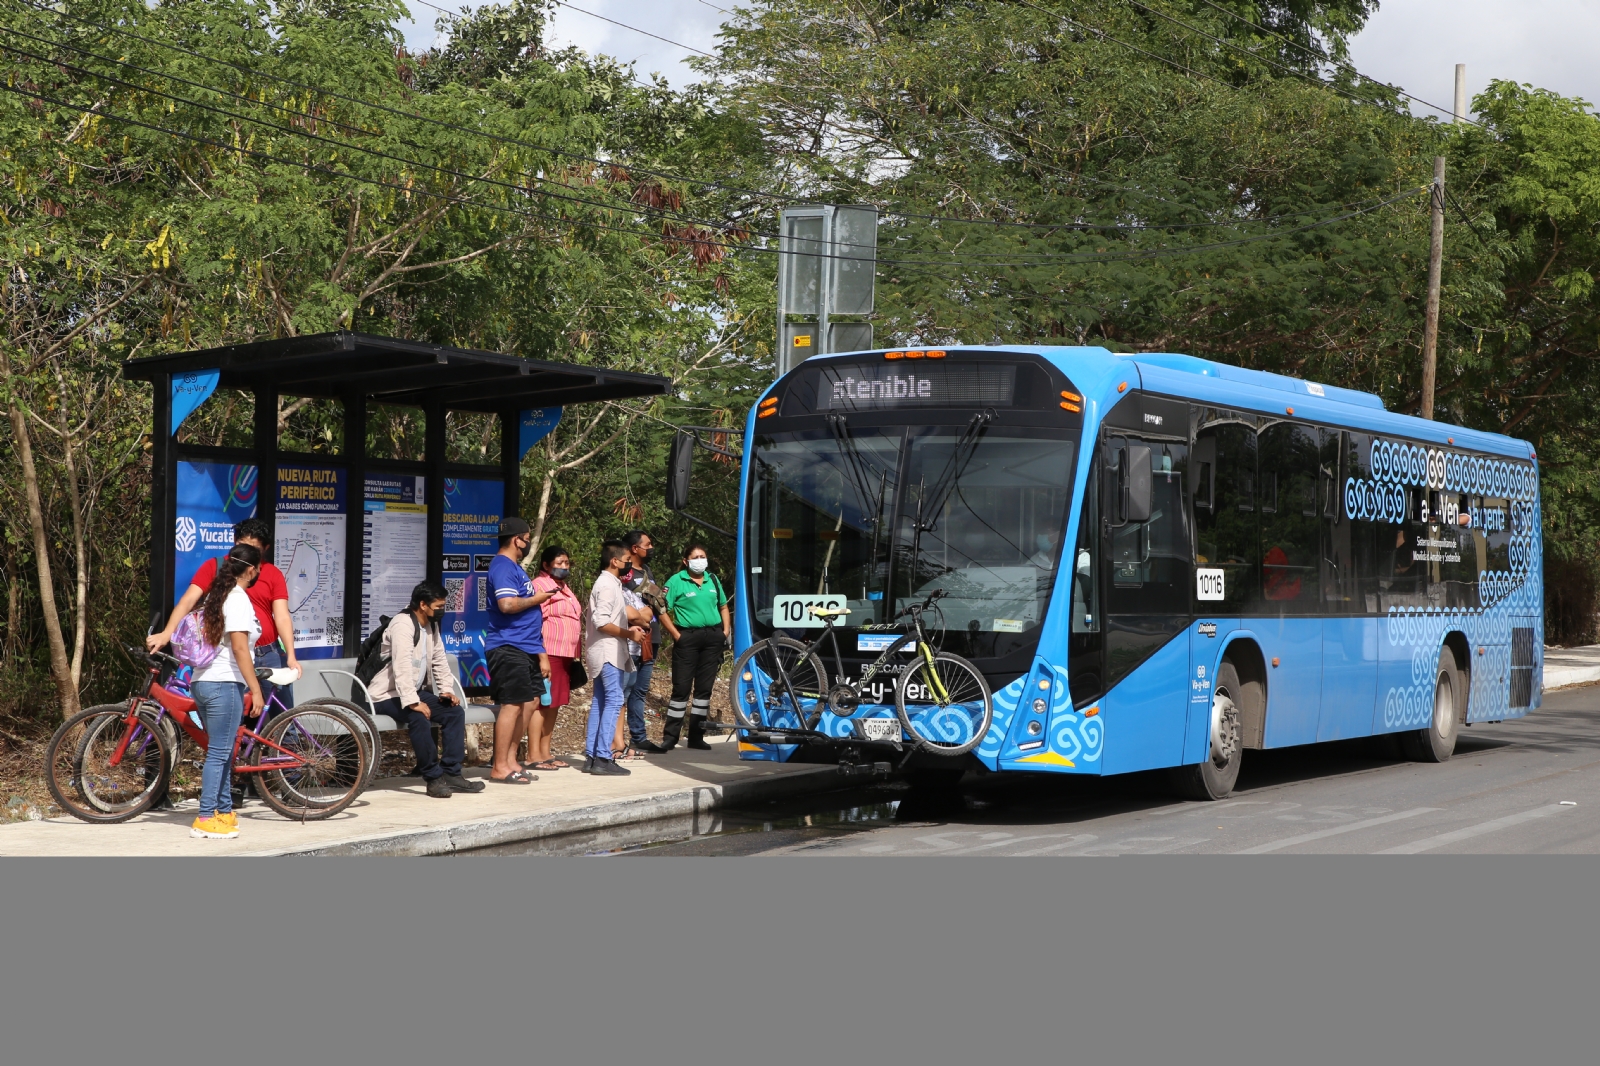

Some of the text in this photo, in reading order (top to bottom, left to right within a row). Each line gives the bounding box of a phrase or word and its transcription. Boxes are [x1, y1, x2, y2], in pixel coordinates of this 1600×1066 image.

[833, 376, 931, 399] stenible
[277, 468, 338, 483] NUEVA RUTA
[280, 484, 336, 500] PERIFÉRICO
[275, 503, 286, 511] ¿YA
[301, 502, 316, 510] CÓMO
[443, 513, 500, 524] DESCARGA LA APP
[443, 524, 482, 532] COMPLETAMENTE
[482, 525, 499, 533] GRATIS
[449, 561, 458, 569] App
[1199, 574, 1222, 594] 10116
[445, 634, 473, 647] Va-y-Ven
